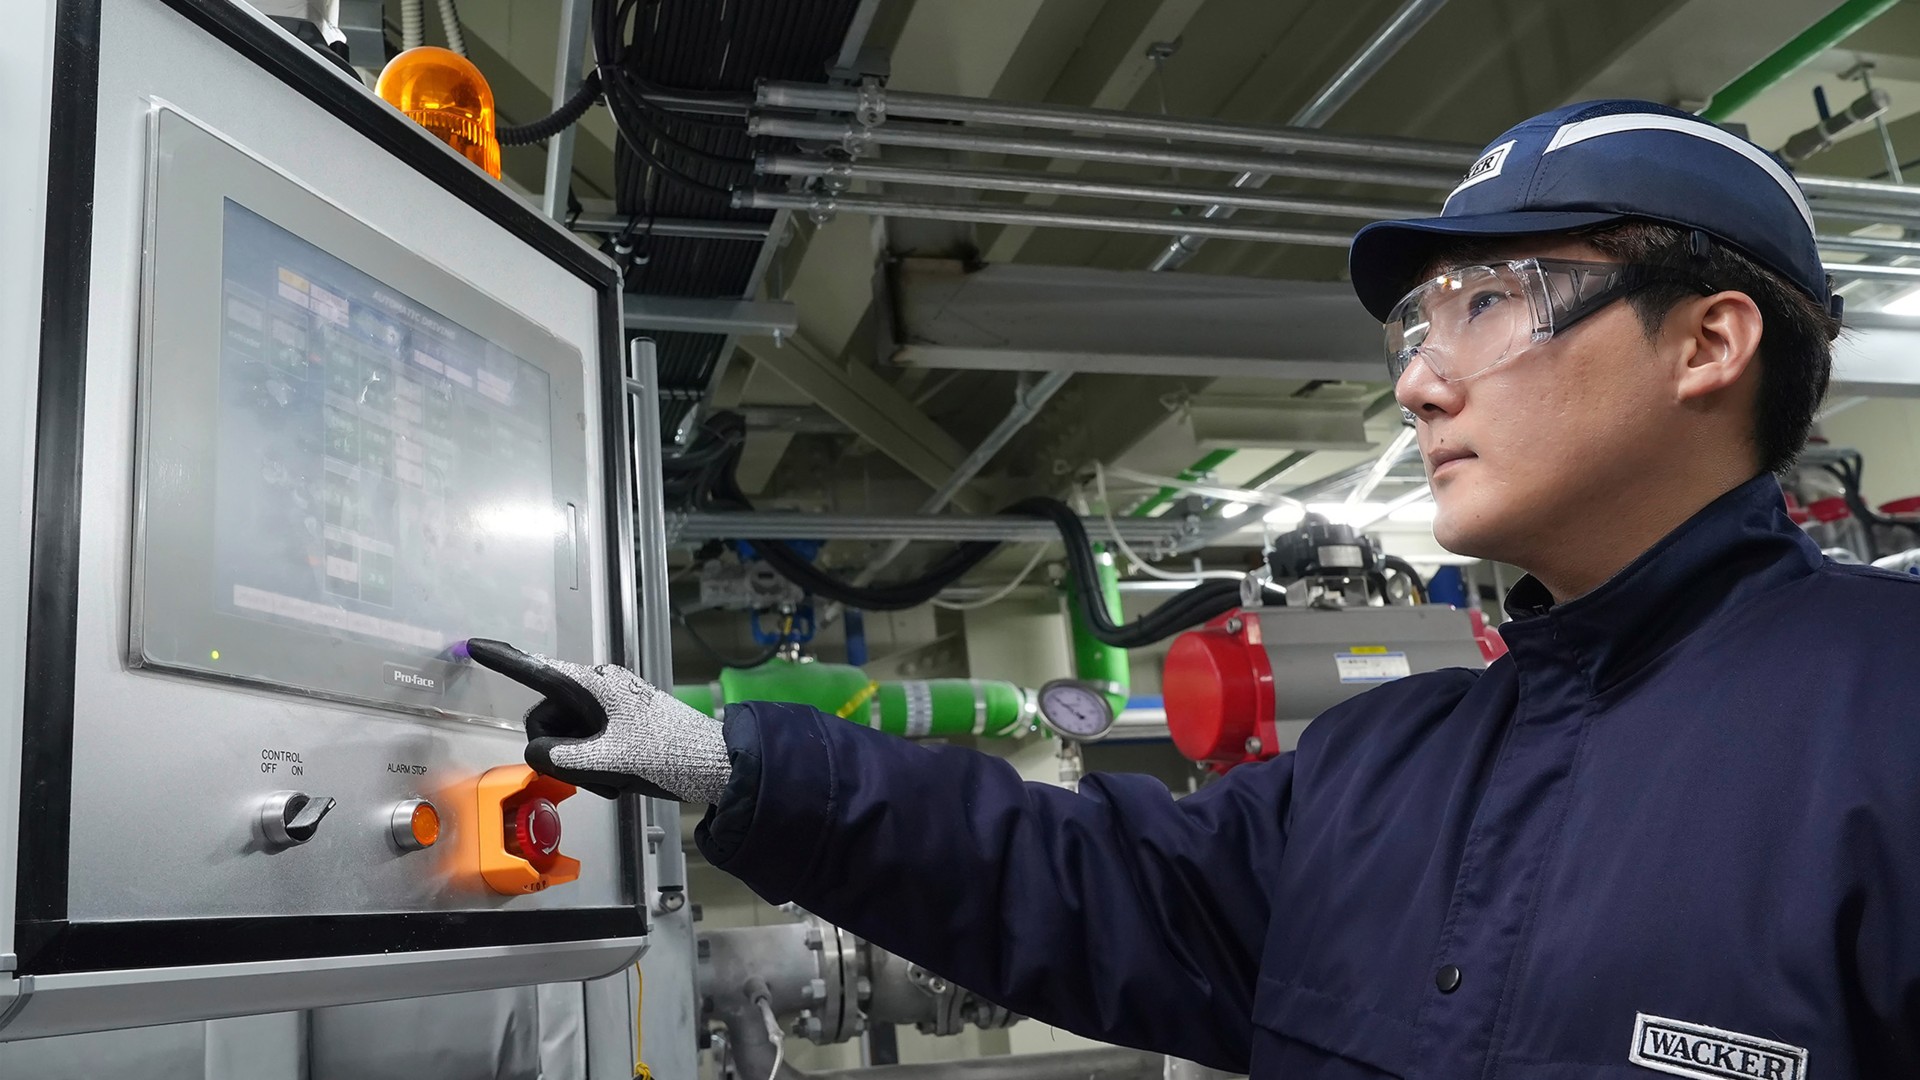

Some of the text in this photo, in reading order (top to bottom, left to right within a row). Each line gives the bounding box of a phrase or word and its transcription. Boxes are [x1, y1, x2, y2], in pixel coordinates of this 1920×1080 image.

[261, 749, 303, 763] CONTROL
[260, 762, 304, 776] OFF ON
[387, 763, 427, 775] ALARM STOP
[1650, 1030, 1786, 1080] WACKER
